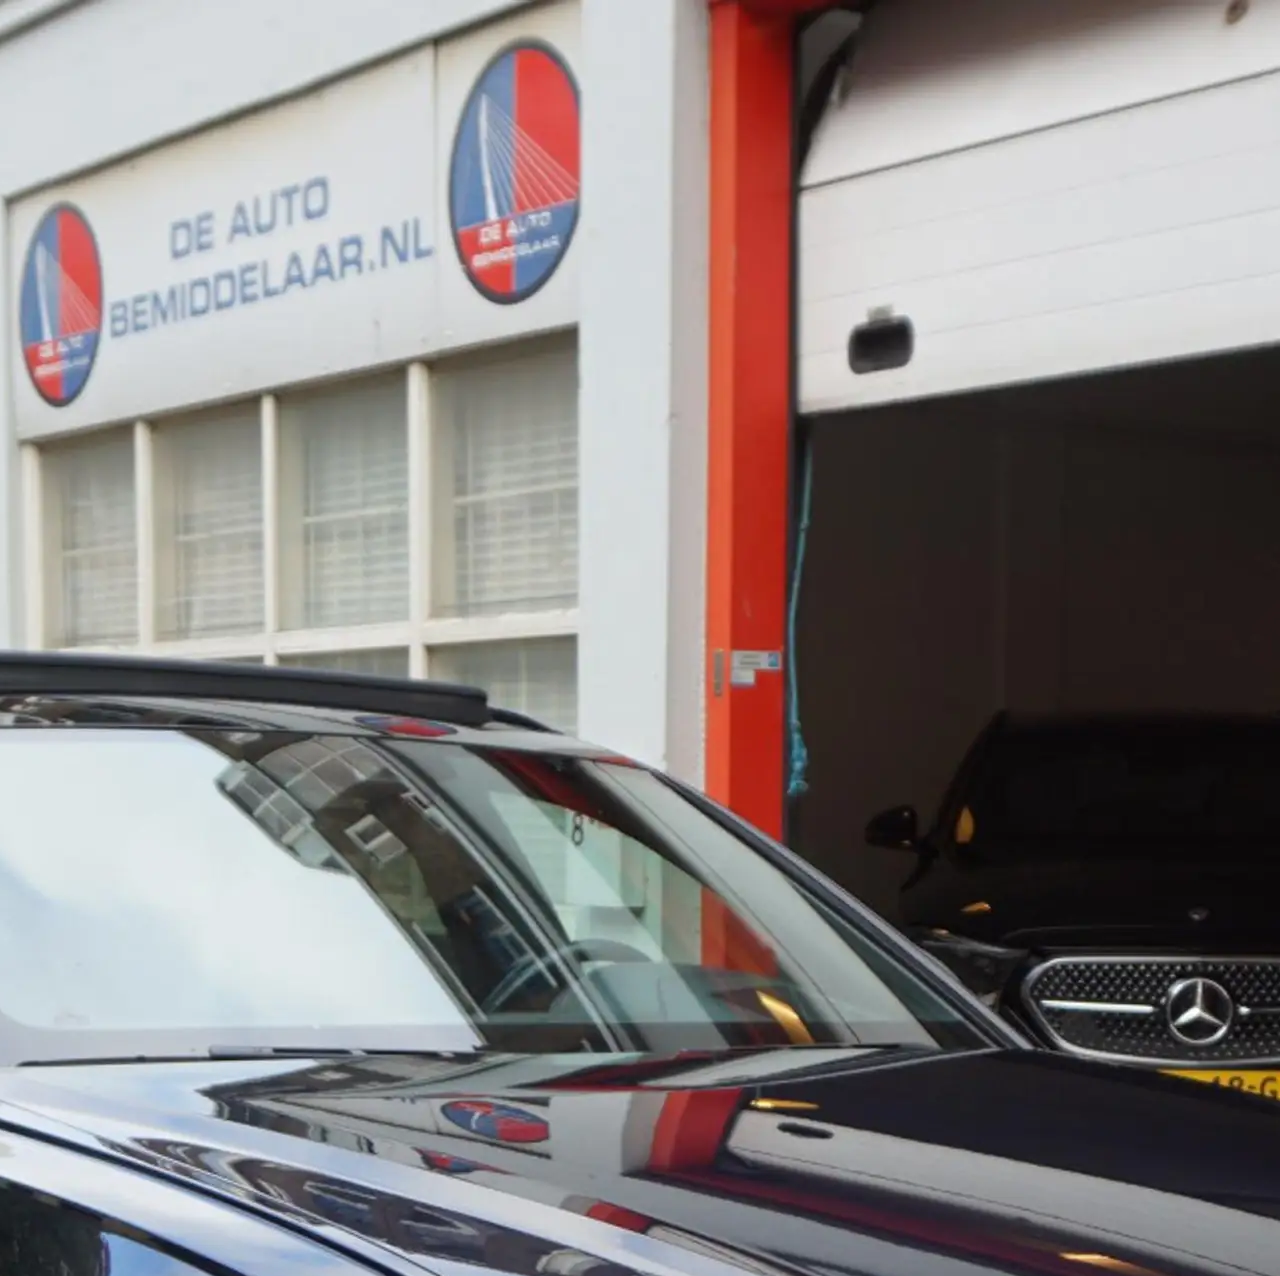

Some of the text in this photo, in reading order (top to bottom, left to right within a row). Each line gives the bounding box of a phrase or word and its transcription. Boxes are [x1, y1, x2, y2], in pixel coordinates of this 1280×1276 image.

[170, 177, 329, 260] DE AUTO
[109, 218, 435, 338] BEMIDDELAAR.NL
